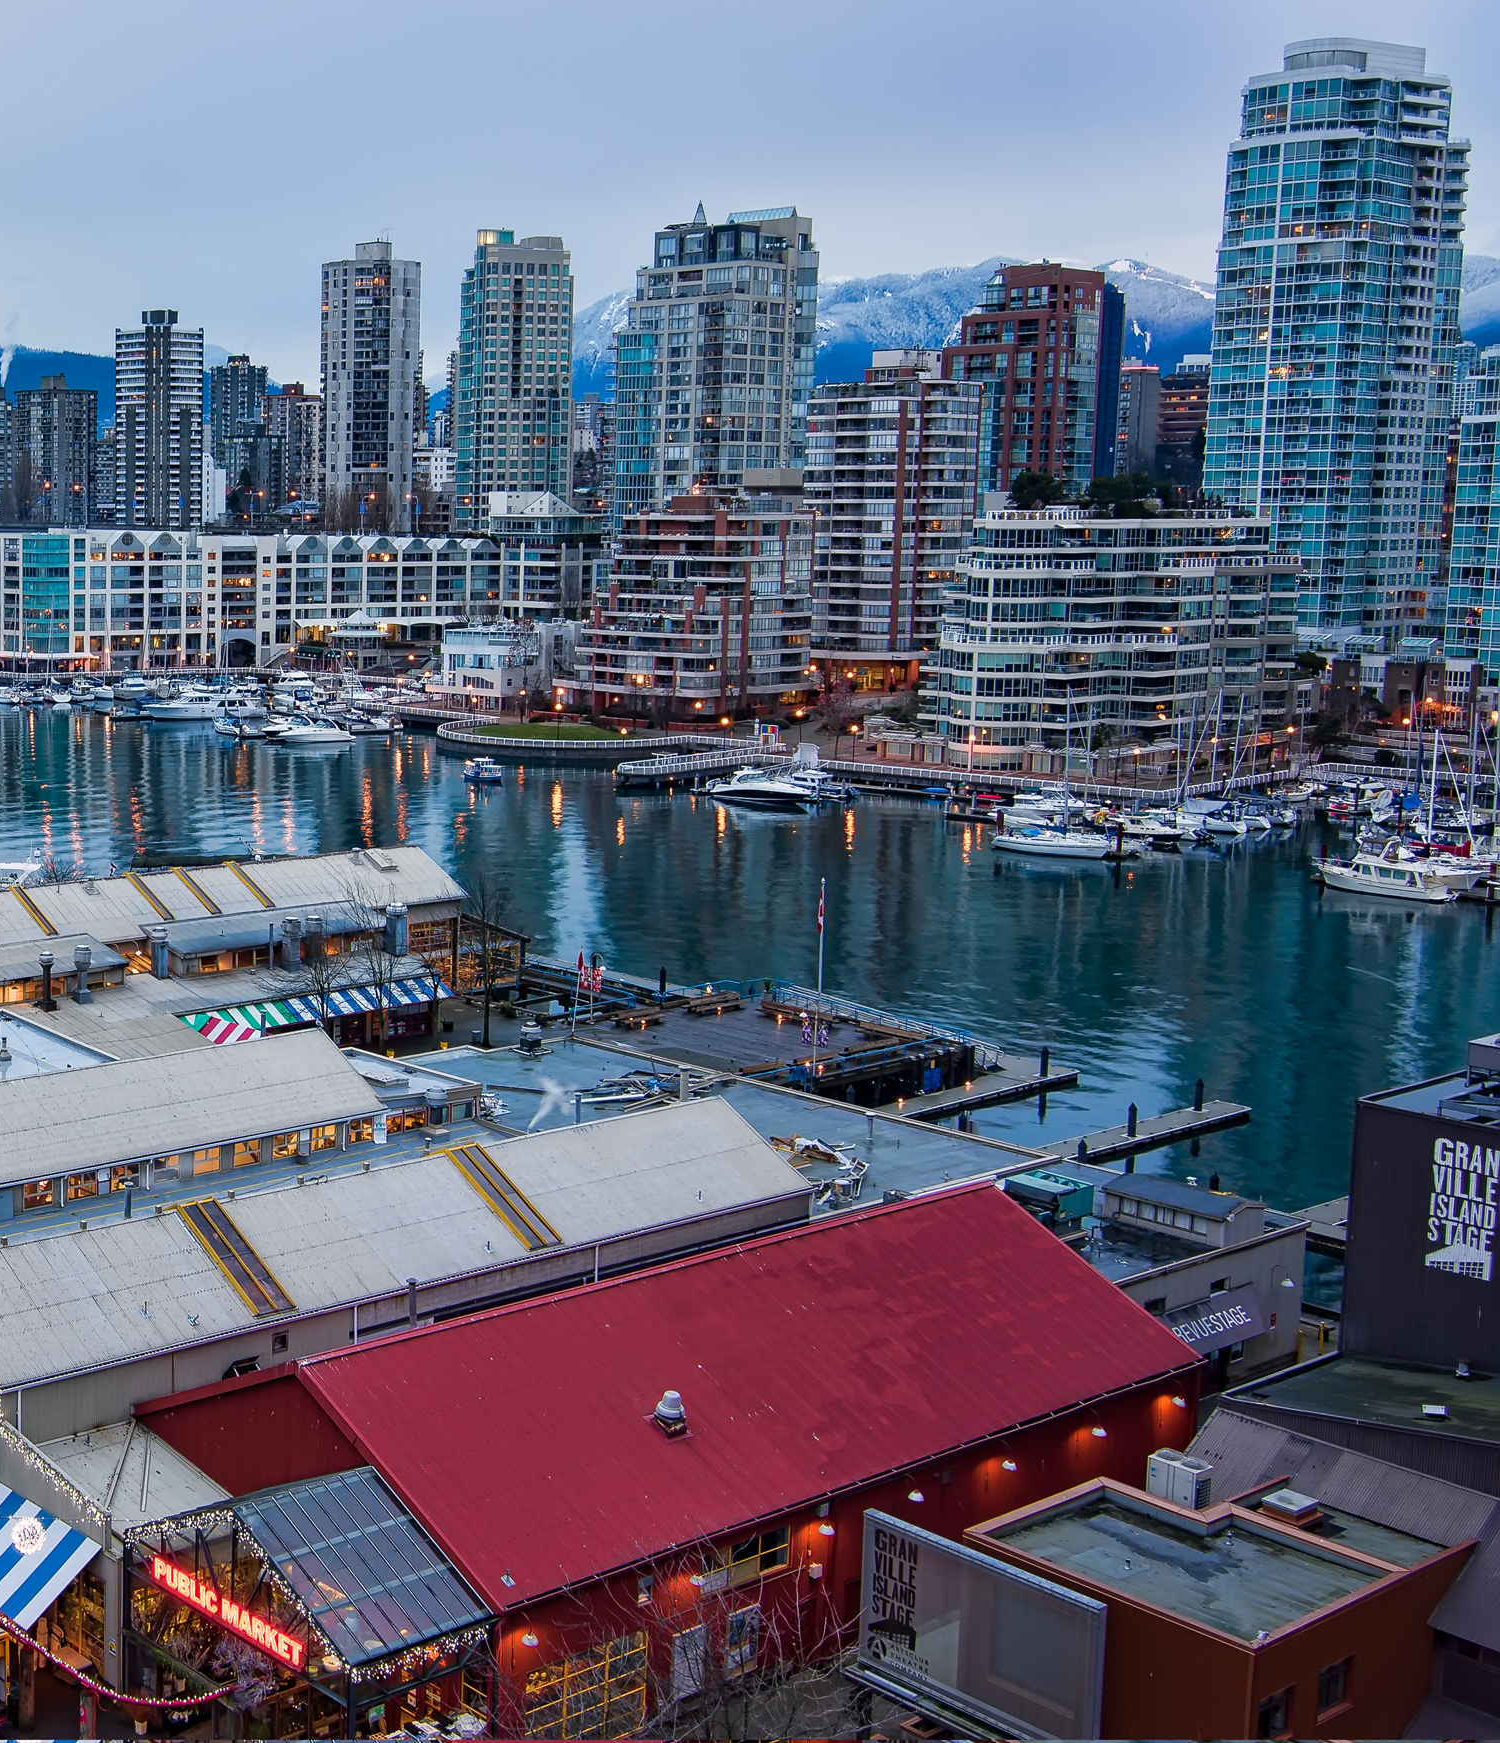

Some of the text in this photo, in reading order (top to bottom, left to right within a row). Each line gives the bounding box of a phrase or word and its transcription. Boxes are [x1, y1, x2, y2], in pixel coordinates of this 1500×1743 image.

[1433, 1137, 1500, 1178] GRAN
[1432, 1164, 1499, 1206] VILLE
[1429, 1192, 1497, 1229] ISLAND
[1427, 1217, 1495, 1251] STAGE
[1171, 1305, 1252, 1344] REVUESTAGE
[874, 1528, 918, 1566] GRAN
[873, 1550, 917, 1590] VILLE
[872, 1573, 916, 1609] ISLAND
[154, 1557, 303, 1666] PUBLIC MARKET
[871, 1594, 915, 1626] STAGE
[889, 1651, 929, 1675] THEATRE
[889, 1660, 929, 1682] COMPANY
